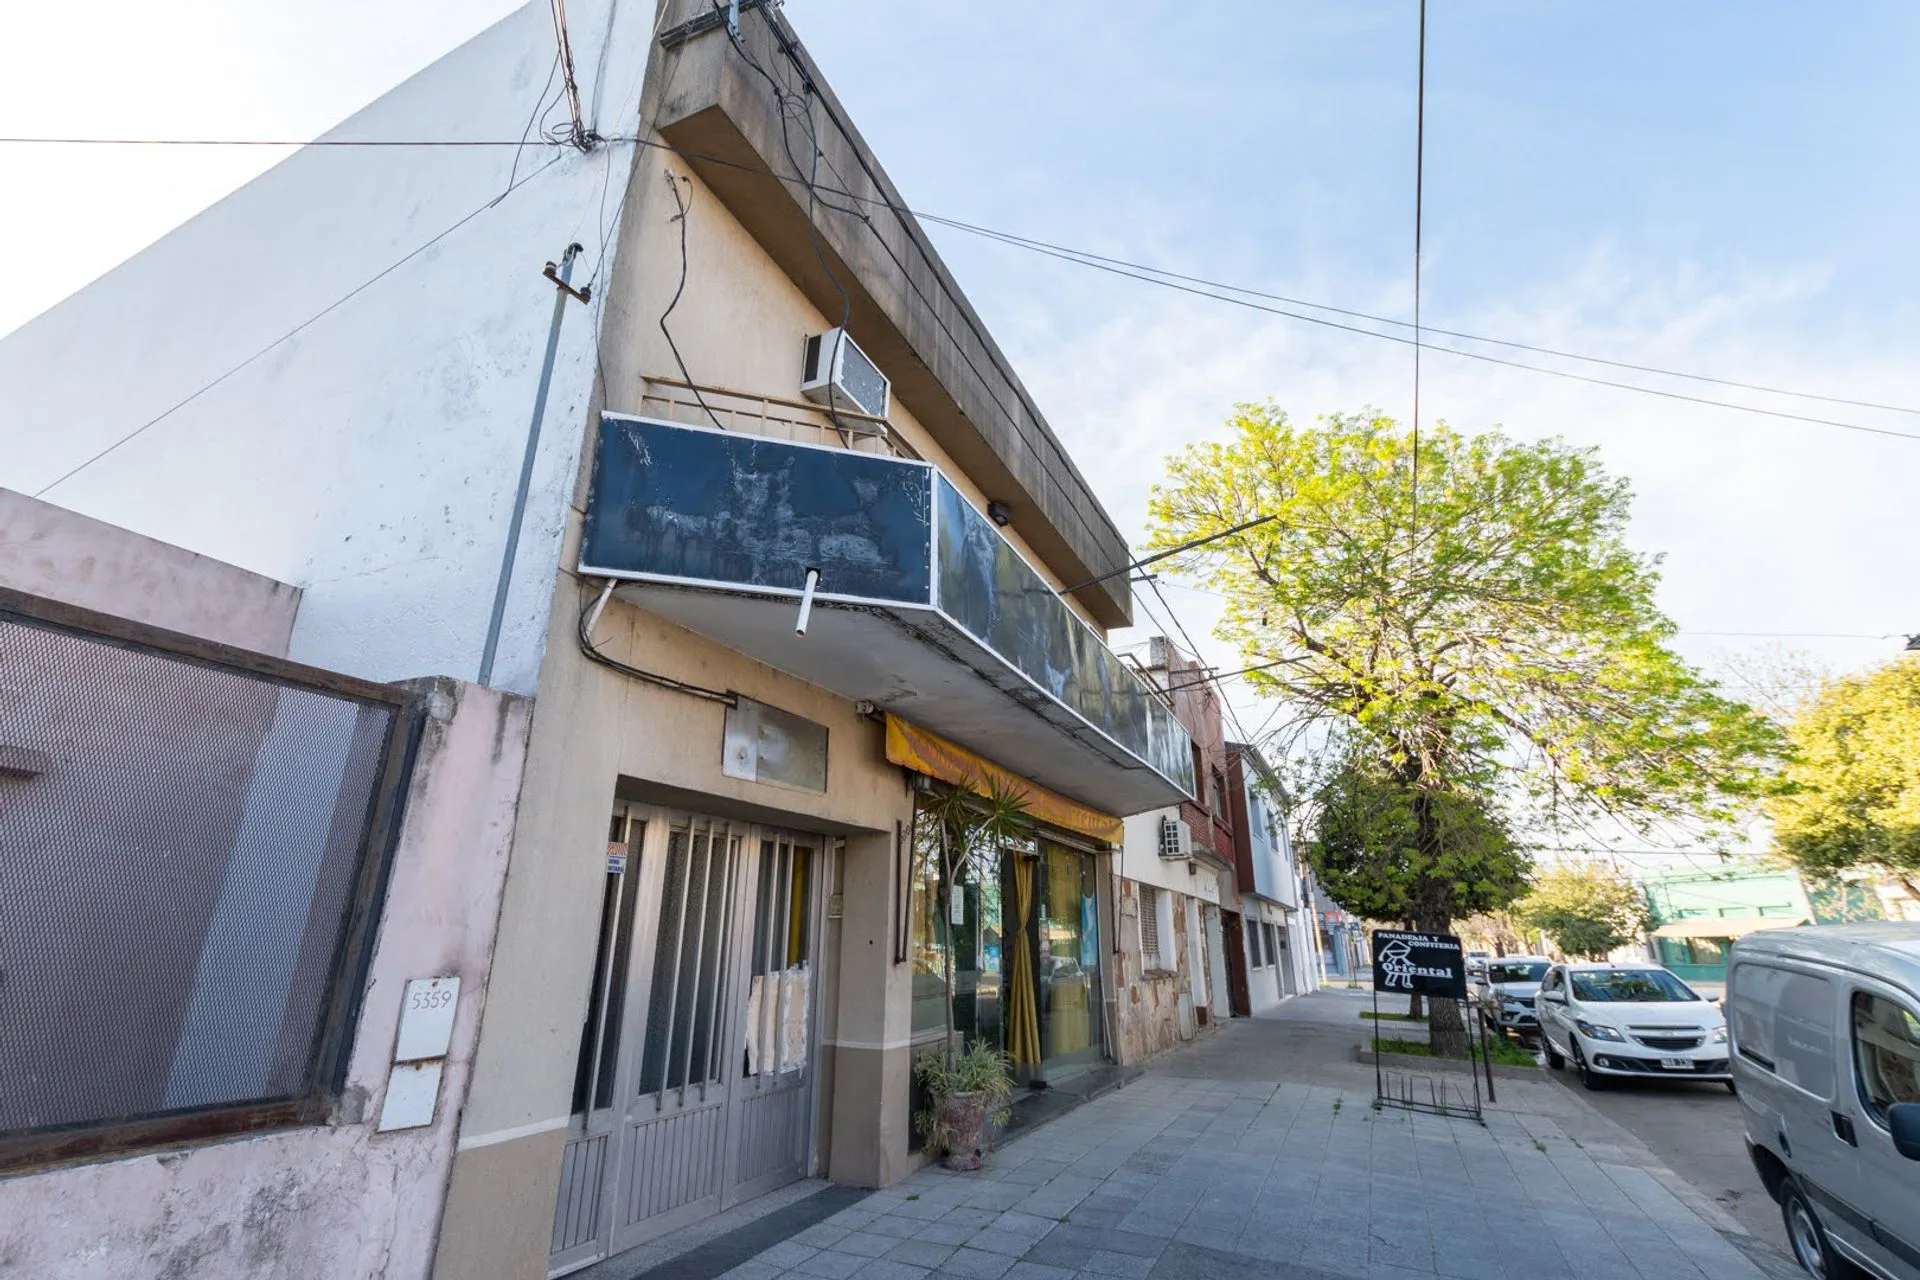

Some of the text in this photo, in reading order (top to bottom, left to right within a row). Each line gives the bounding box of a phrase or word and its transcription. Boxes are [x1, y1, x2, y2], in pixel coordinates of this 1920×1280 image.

[1407, 940, 1460, 950] CONFITERIA
[1382, 962, 1453, 979] Oriental
[411, 989, 452, 1010] 5359
